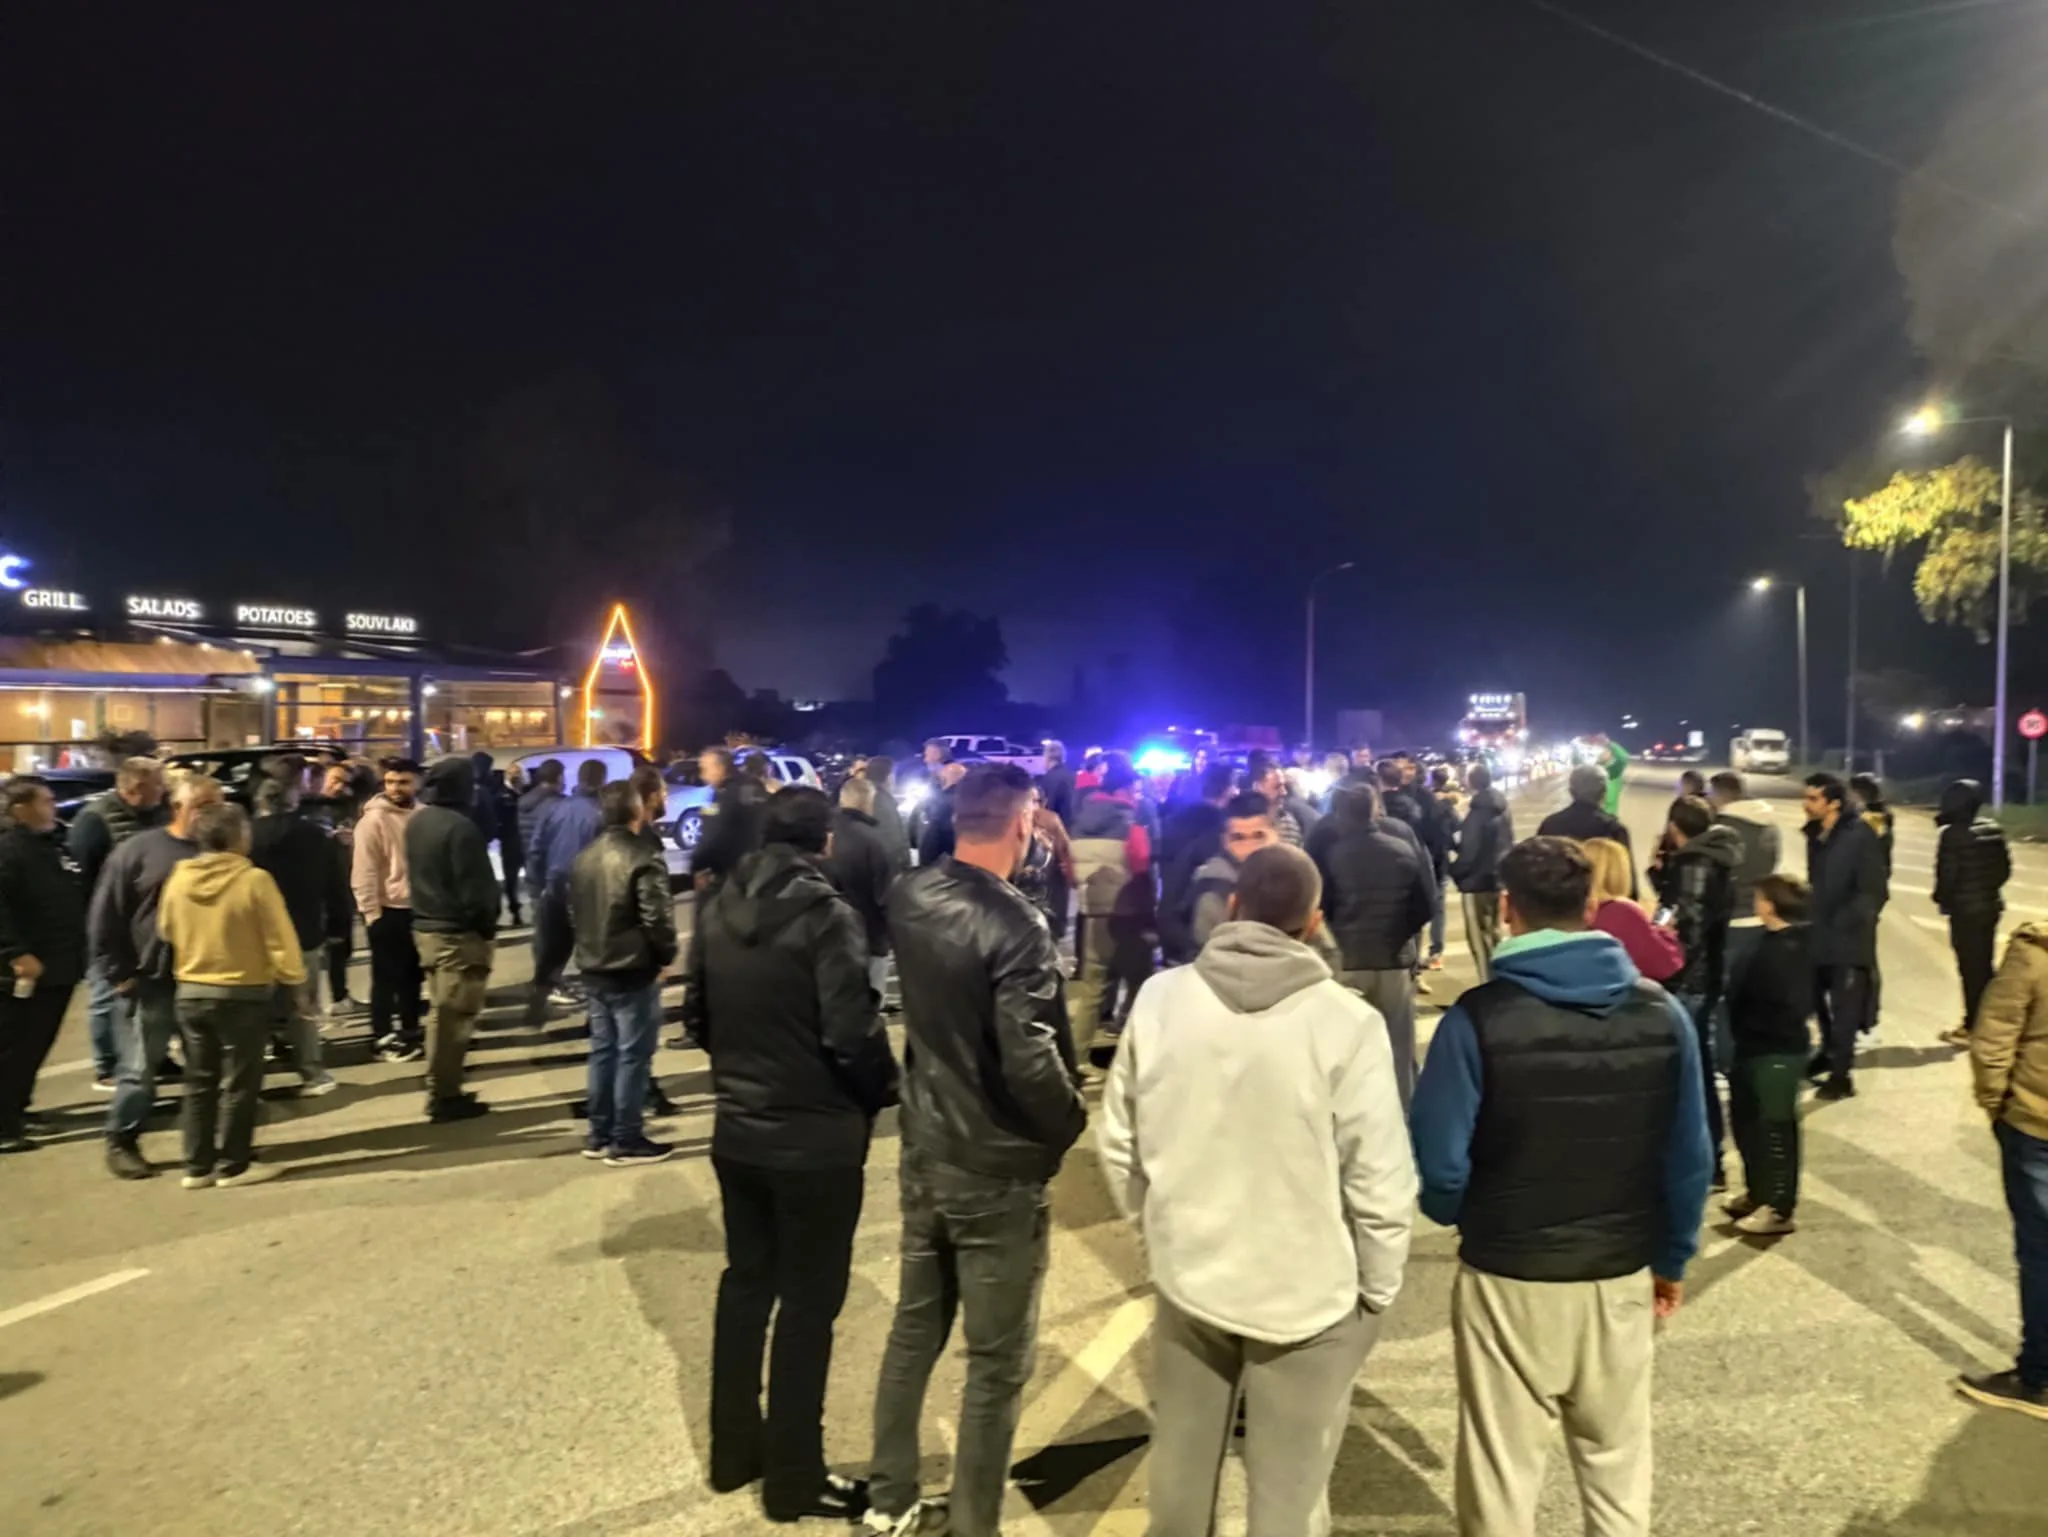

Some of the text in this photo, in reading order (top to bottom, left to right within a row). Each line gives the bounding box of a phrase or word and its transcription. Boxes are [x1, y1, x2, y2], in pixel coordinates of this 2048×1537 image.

[23, 588, 90, 611] GRILL
[127, 595, 203, 619] SALADS
[237, 605, 317, 627] POTATOES
